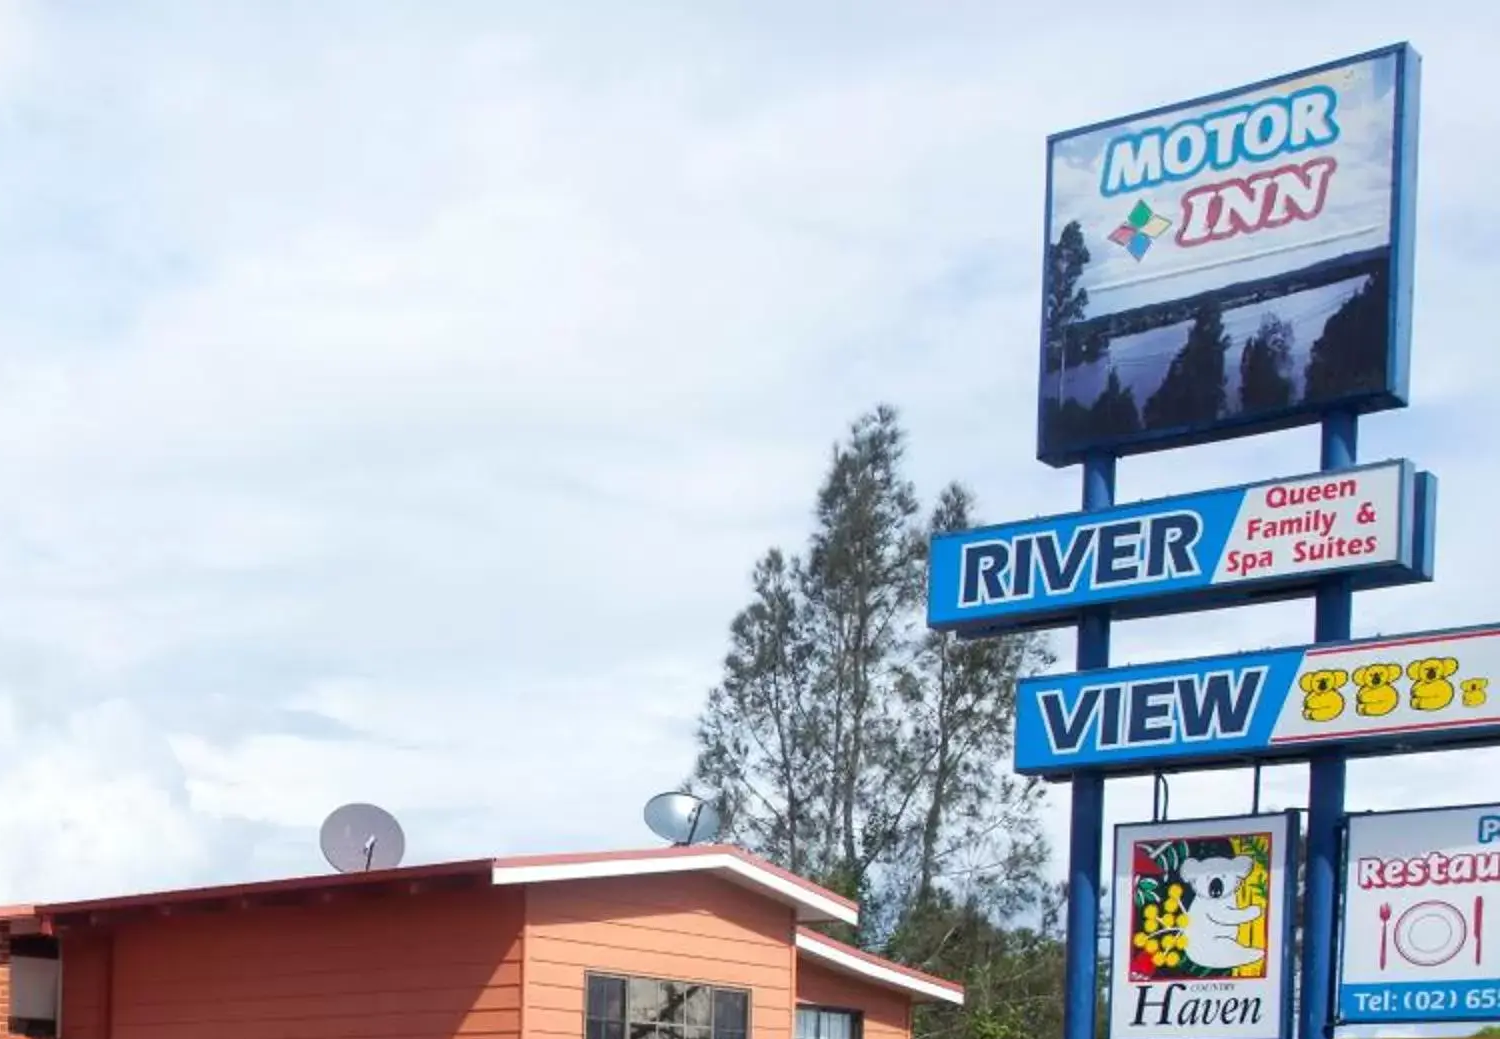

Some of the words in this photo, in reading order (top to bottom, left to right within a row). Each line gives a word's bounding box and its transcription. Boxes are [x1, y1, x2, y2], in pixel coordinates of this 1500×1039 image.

[1100, 85, 1340, 198] MOTOR
[1175, 157, 1337, 247] INN
[1265, 479, 1357, 509] Queen
[1247, 509, 1336, 541] Family
[1356, 502, 1376, 524] &
[958, 510, 1204, 608] RIVER
[1225, 550, 1273, 576] Spa
[1293, 535, 1377, 563] Suites
[1036, 666, 1269, 754] VIEW
[1358, 851, 1500, 889] Restau
[1129, 983, 1262, 1026] Haven
[1353, 991, 1398, 1012] Tel:
[1404, 989, 1457, 1011] (02)
[1465, 987, 1500, 1009] 65
